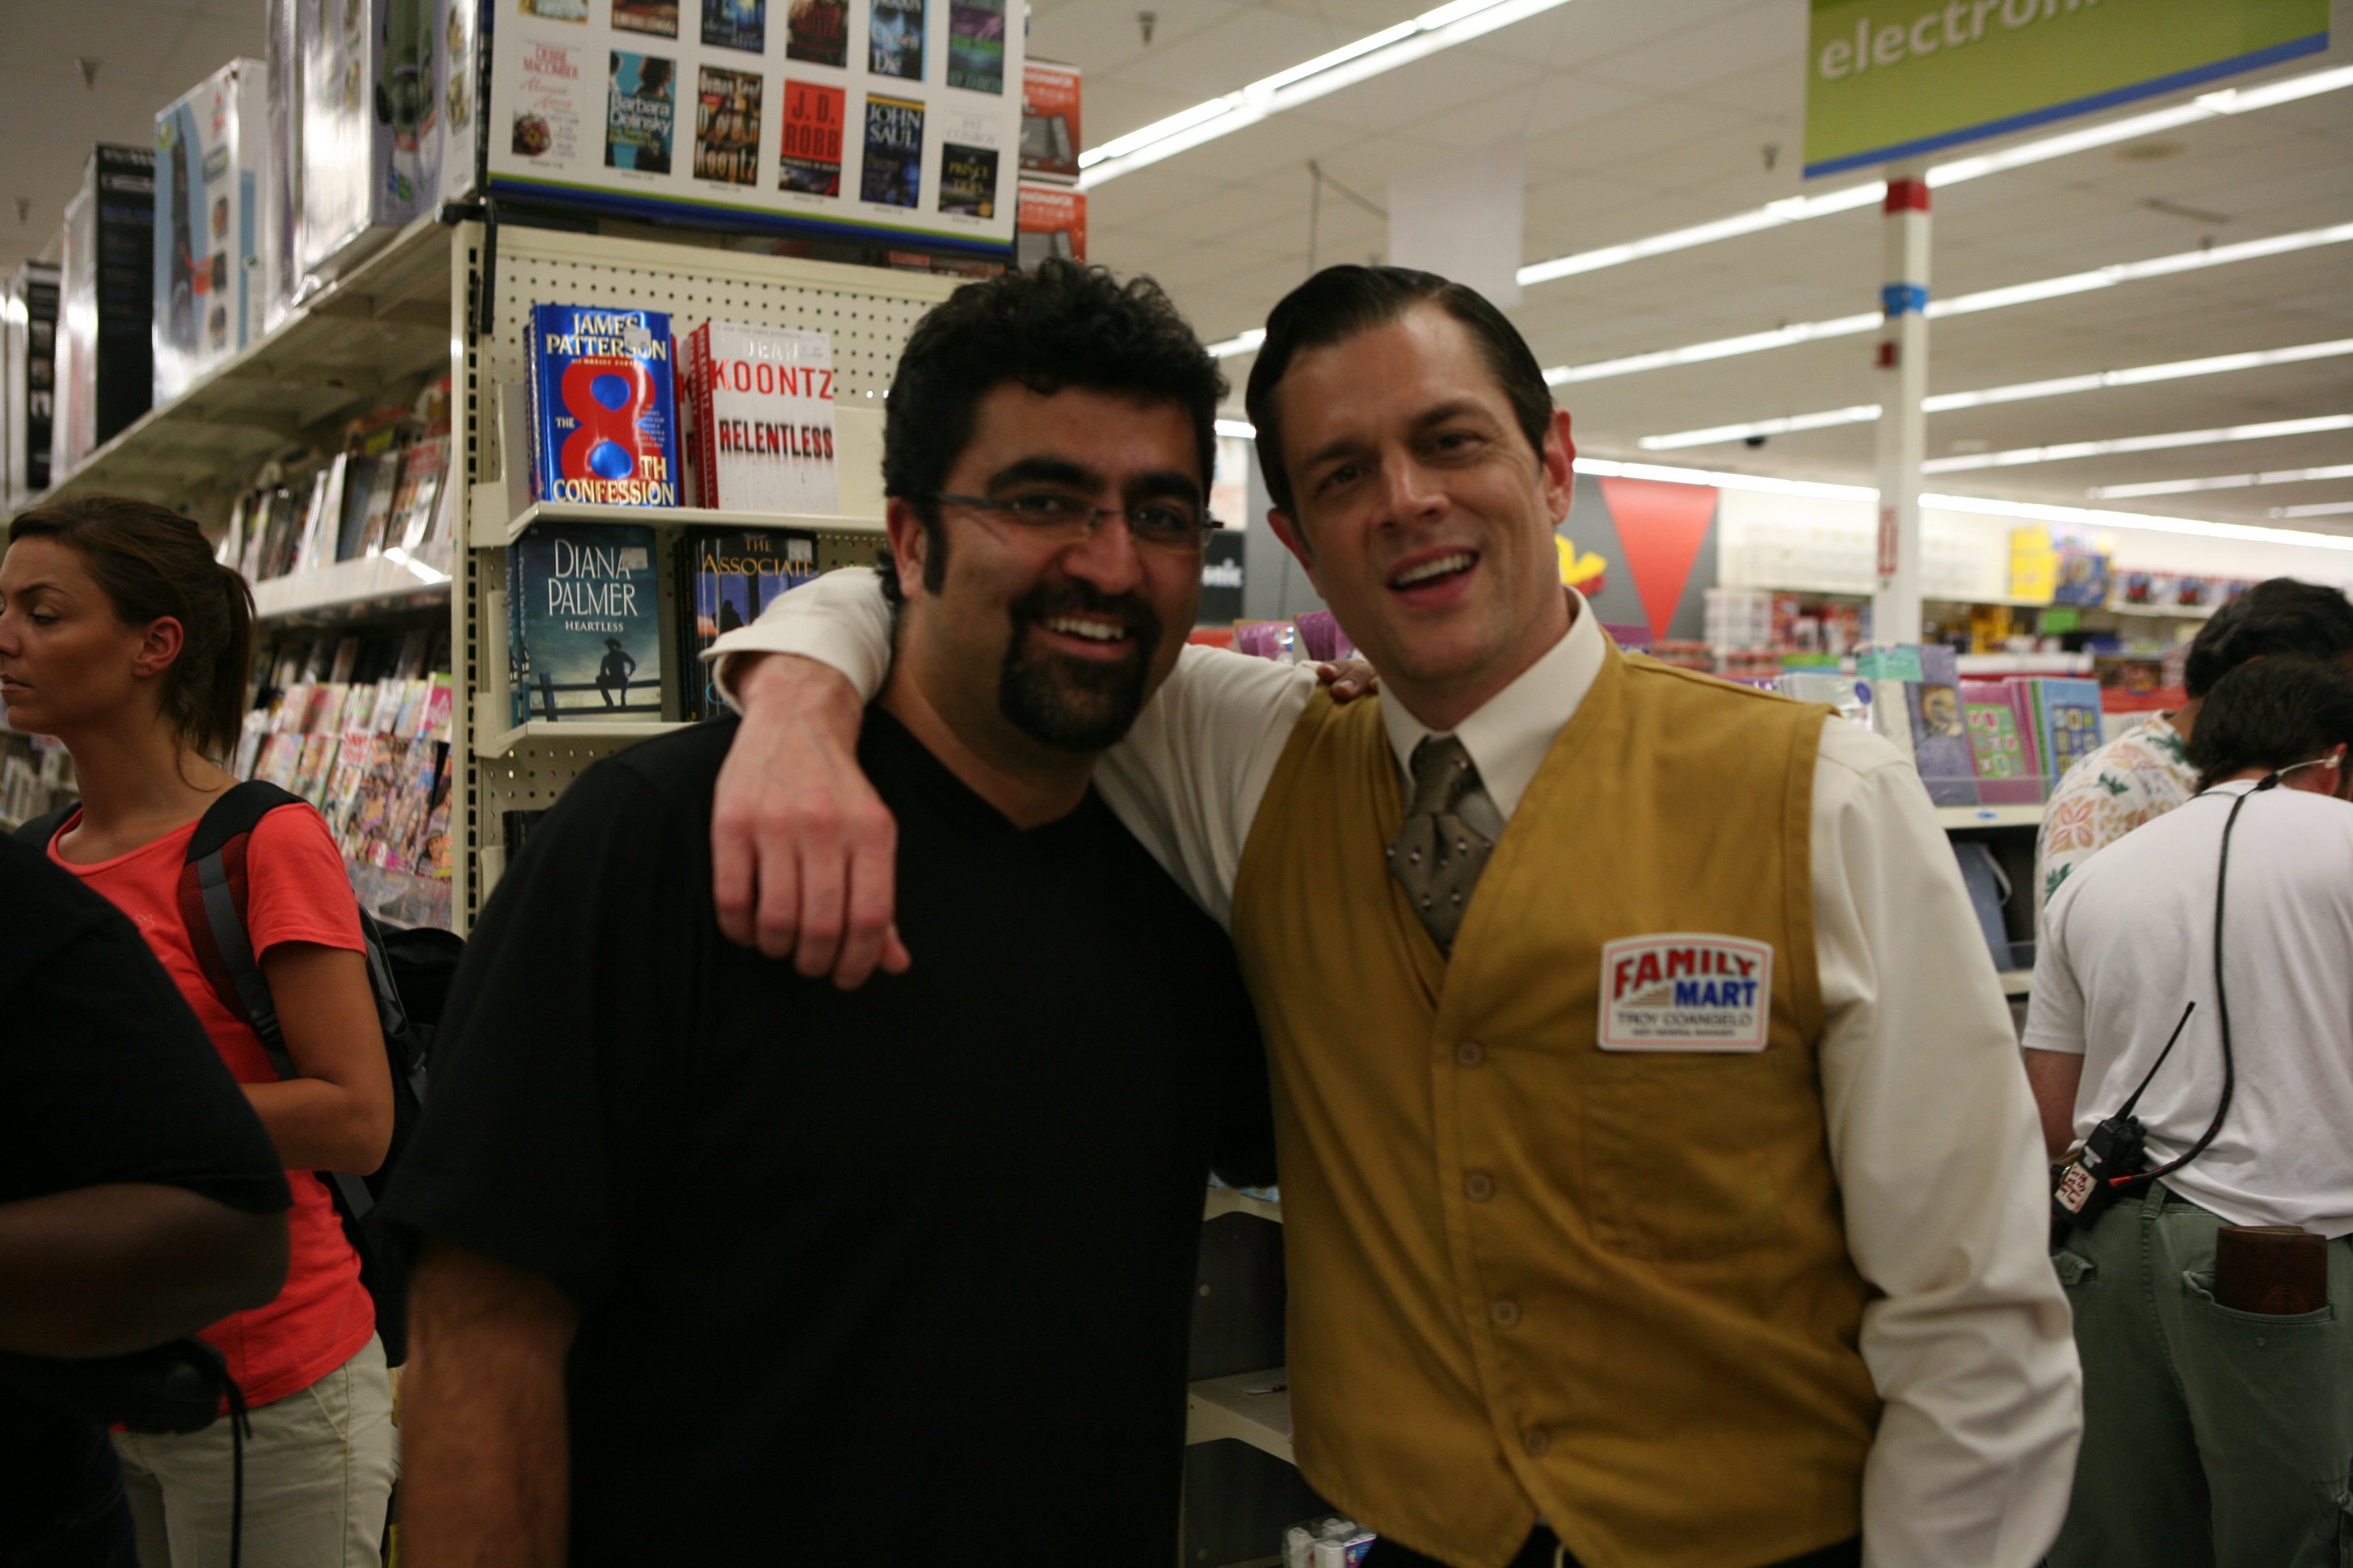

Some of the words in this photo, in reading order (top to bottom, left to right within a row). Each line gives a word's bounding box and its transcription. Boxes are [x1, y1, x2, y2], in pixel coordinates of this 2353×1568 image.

[1819, 0, 2098, 80] electro
[610, 90, 670, 117] Barbara
[869, 103, 922, 130] JOHN
[785, 122, 839, 158] ROBB
[869, 124, 919, 150] SAUL
[711, 358, 834, 400] KOONTZ
[556, 416, 575, 429] THE
[718, 419, 834, 460] RELENTLESS
[553, 478, 675, 506] CONFESSION
[554, 538, 631, 580] DIANA
[745, 539, 773, 553] THE
[702, 553, 814, 578] ASSOCIATE
[548, 578, 638, 617] PALMER
[565, 620, 624, 633] HEARTLESS
[1614, 948, 1755, 1001] FAMILY
[1673, 980, 1757, 1008] MART
